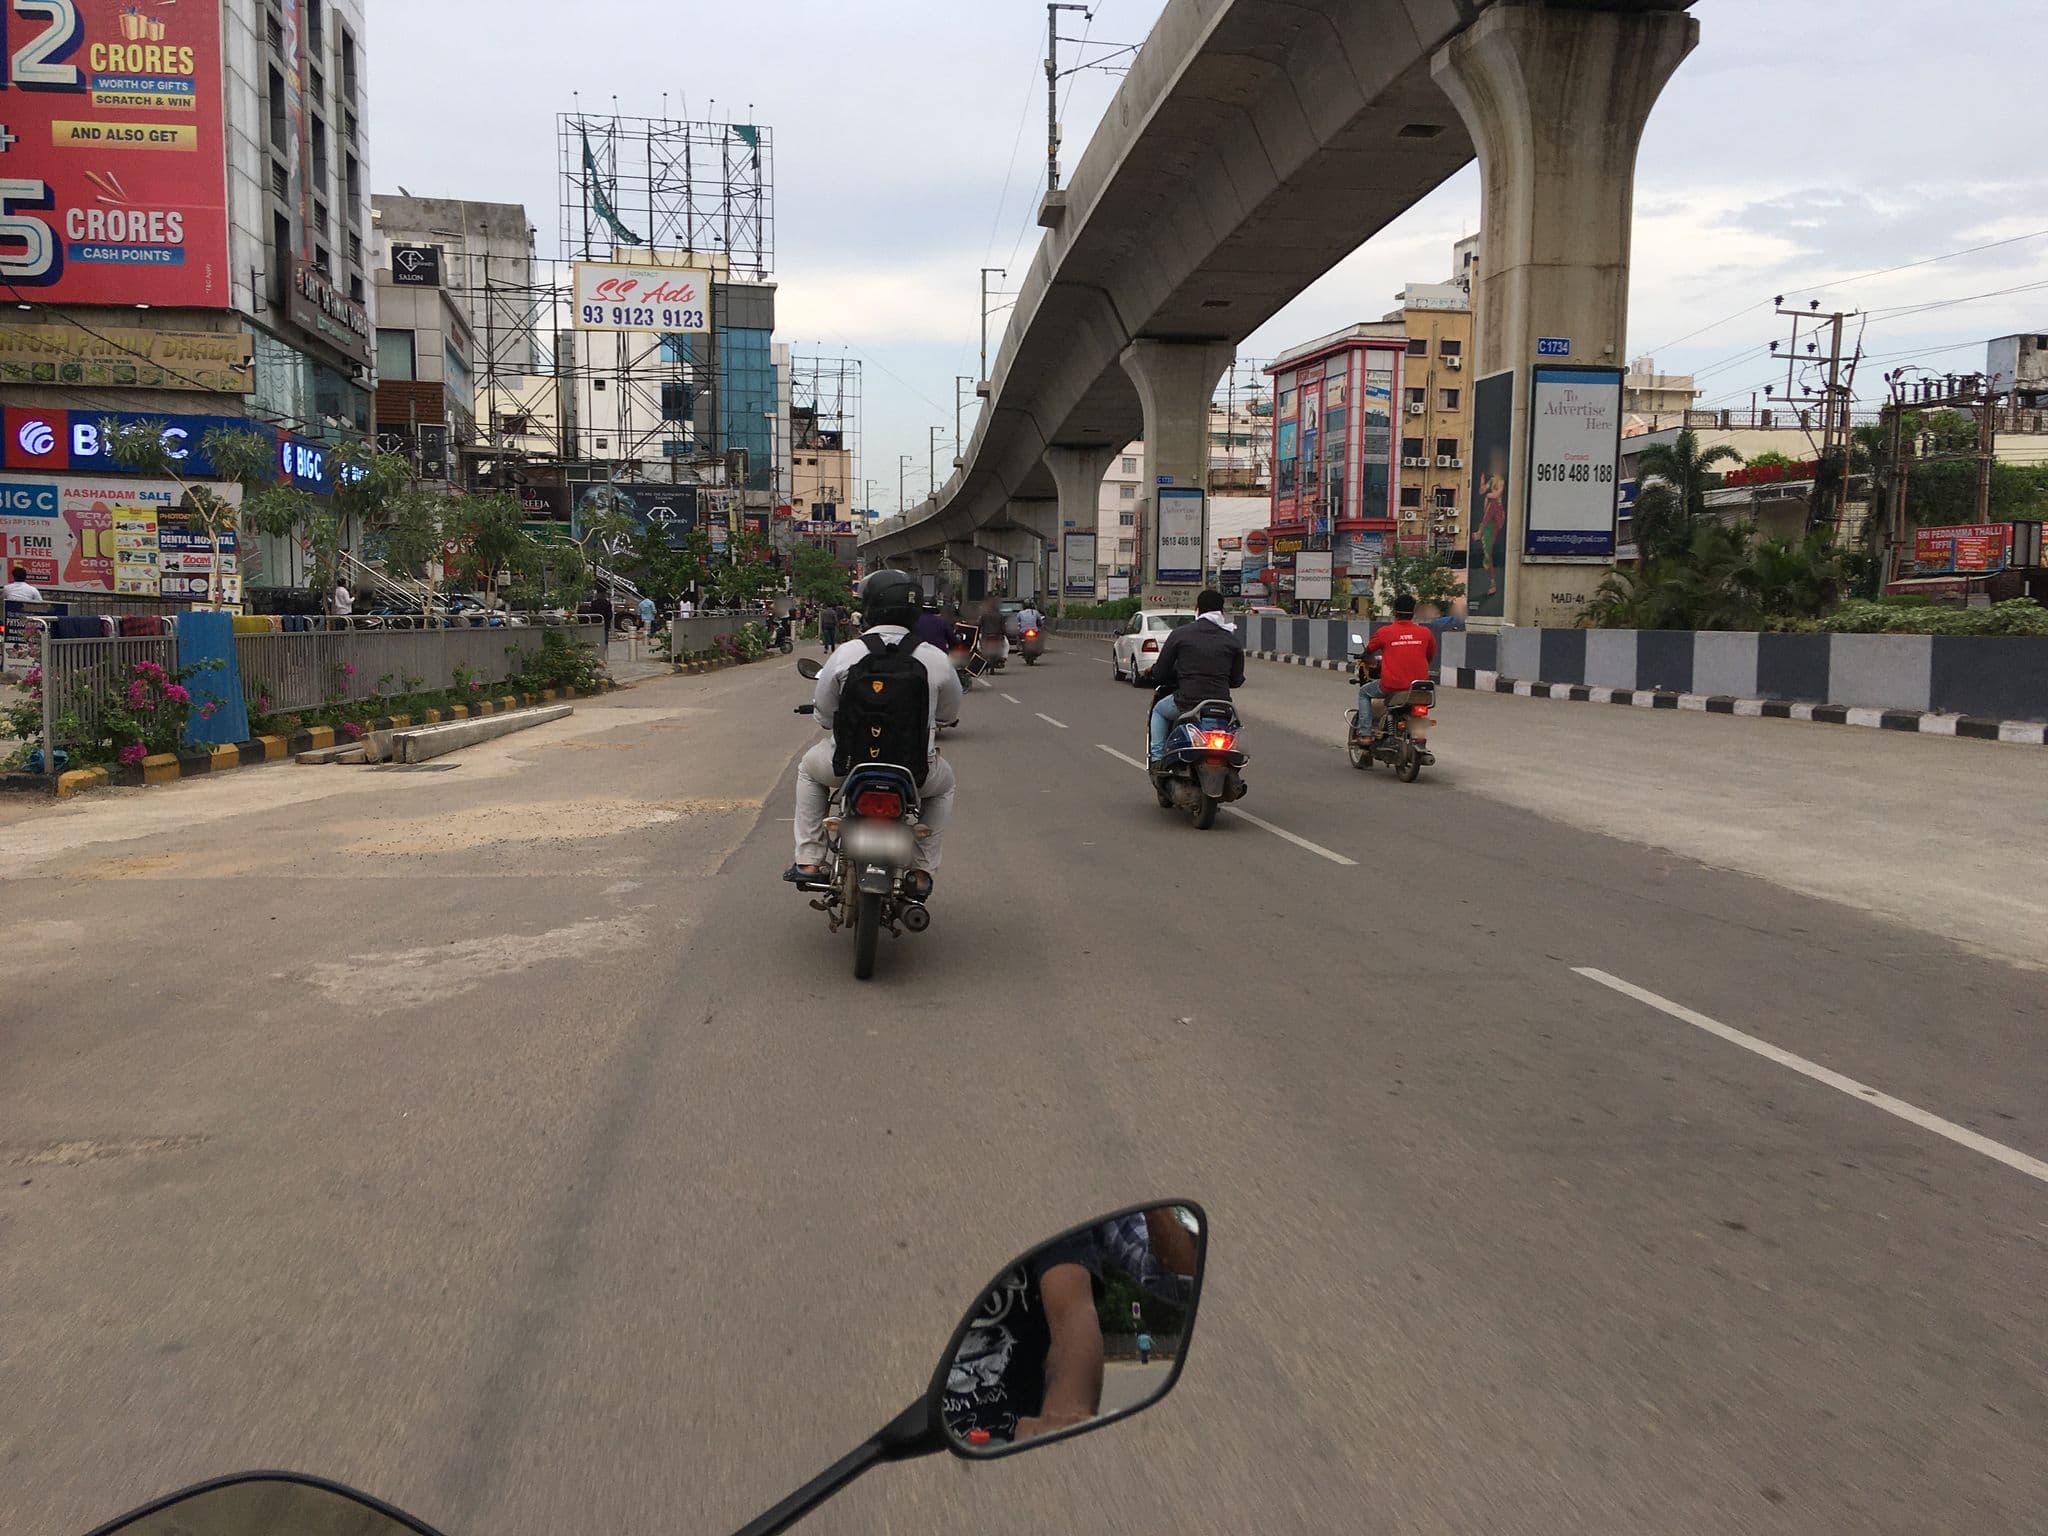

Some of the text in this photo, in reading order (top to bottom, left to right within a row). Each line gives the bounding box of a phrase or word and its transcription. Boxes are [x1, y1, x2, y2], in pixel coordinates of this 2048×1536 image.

[90, 43, 194, 75] CRORES
[98, 79, 188, 92] WORTH OF GIFTS
[96, 95, 191, 107] SCRATCH & WIN
[71, 127, 178, 142] AND ALSO GET
[66, 208, 184, 243] CRORES
[83, 248, 119, 260] CASH
[398, 273, 424, 281] SALON
[588, 278, 696, 304] SS Ads
[583, 305, 703, 328] 93 9123 9123
[1539, 340, 1569, 353] C1734
[1564, 389, 1578, 402] To
[1544, 402, 1606, 417] Advertise
[1585, 417, 1612, 430] Here
[1537, 463, 1613, 483] 9618 488 188
[64, 489, 171, 500] AASHADAM SALE
[1975, 525, 2002, 536] THALLI
[10, 536, 52, 555] 1 EMI
[161, 535, 192, 544] DENTAL
[24, 548, 52, 557] FREE
